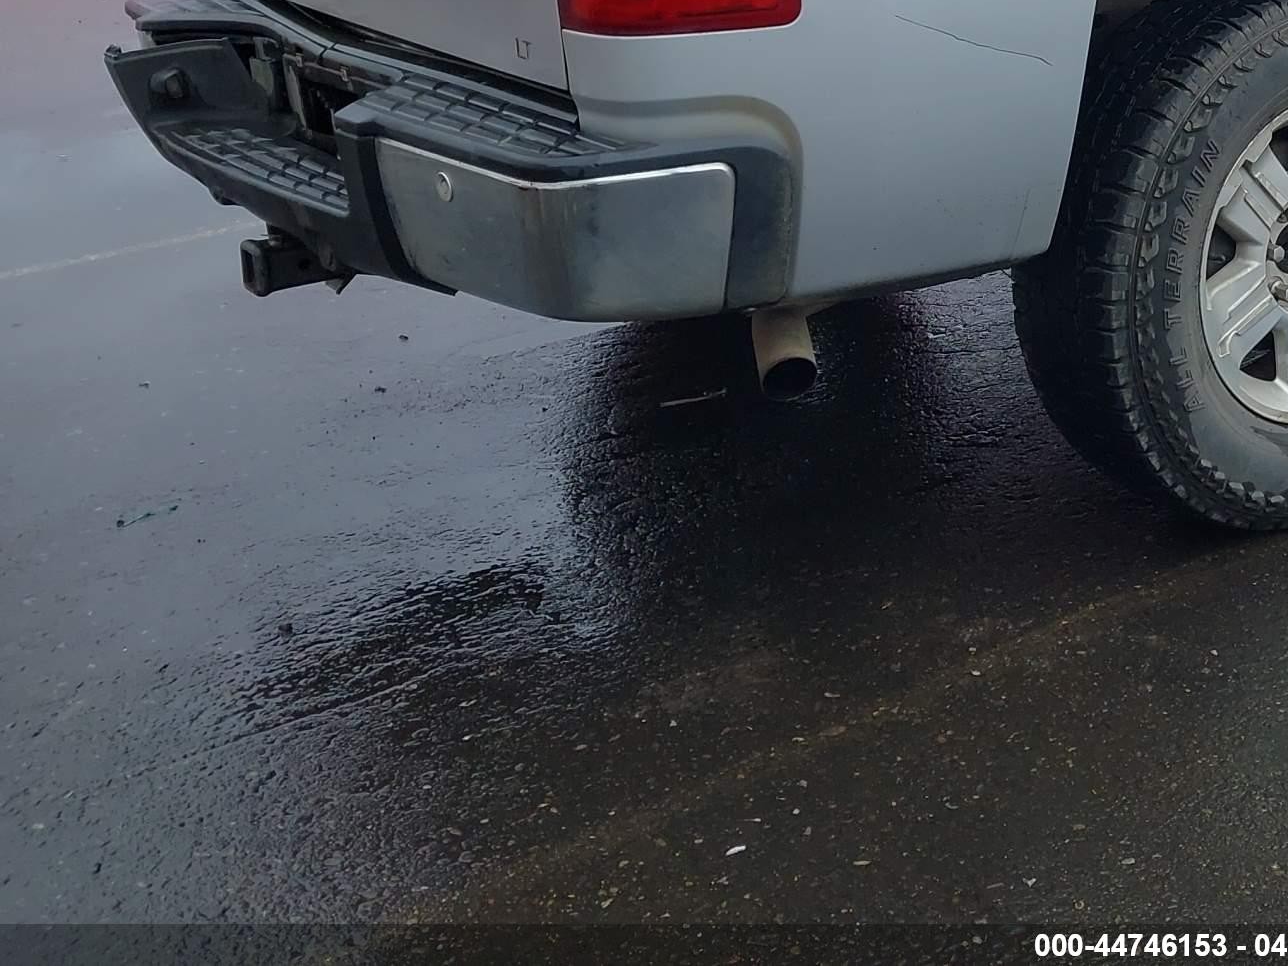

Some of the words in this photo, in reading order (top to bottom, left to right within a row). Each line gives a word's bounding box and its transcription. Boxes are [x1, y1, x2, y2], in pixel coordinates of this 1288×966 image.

[514, 37, 533, 60] LT
[1163, 138, 1222, 330] TERRAIN
[1168, 345, 1205, 413] ALL
